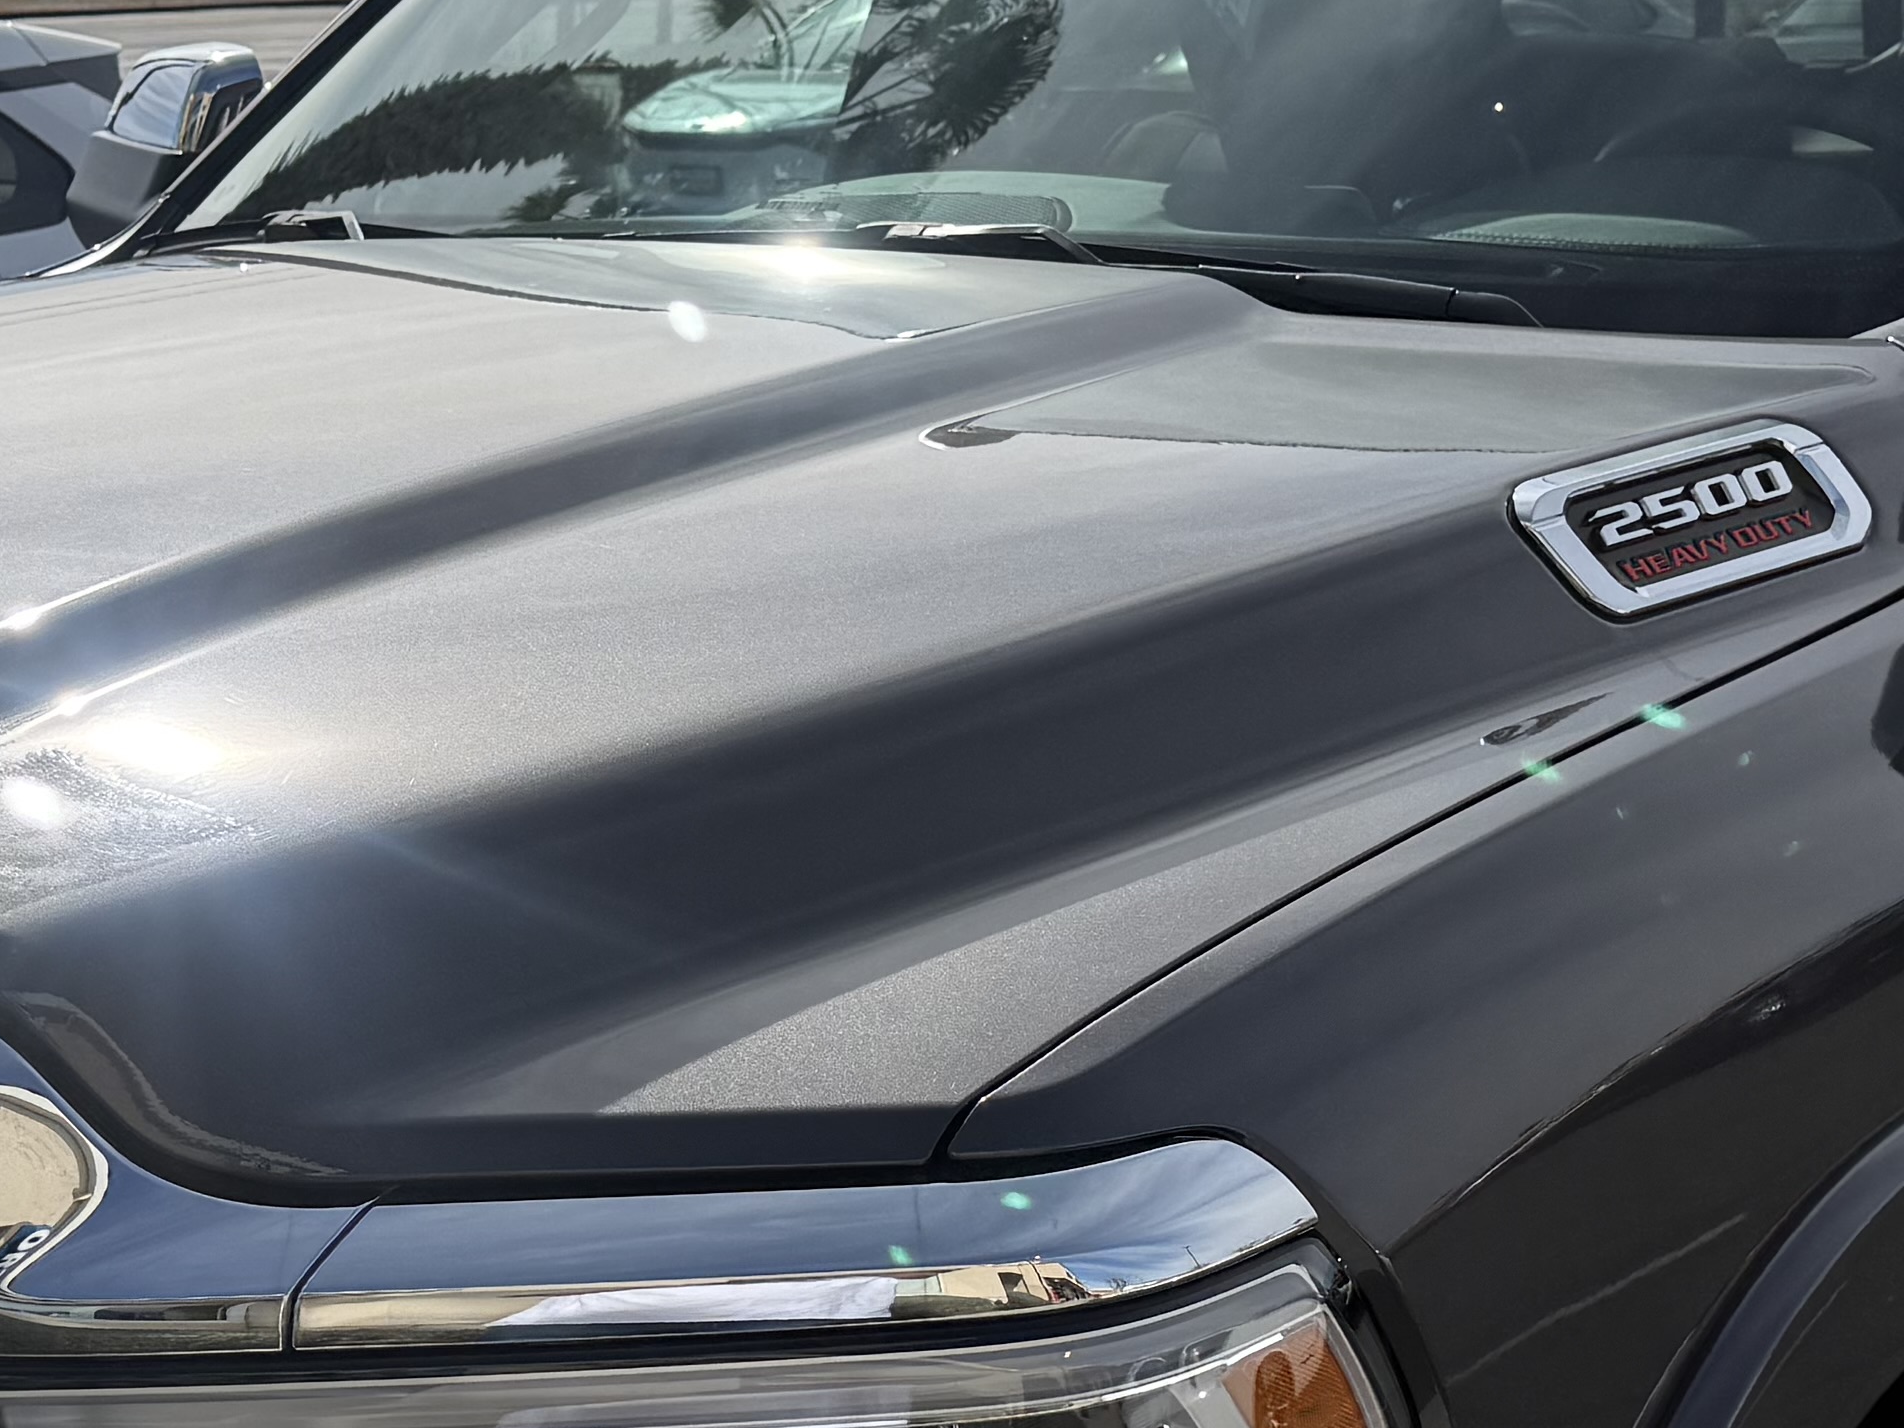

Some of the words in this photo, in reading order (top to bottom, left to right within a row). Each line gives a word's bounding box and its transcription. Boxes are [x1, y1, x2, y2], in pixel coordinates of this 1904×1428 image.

[1589, 460, 1793, 547] 2500
[1623, 532, 1729, 581] HEAVY
[1735, 510, 1813, 549] DUTY
